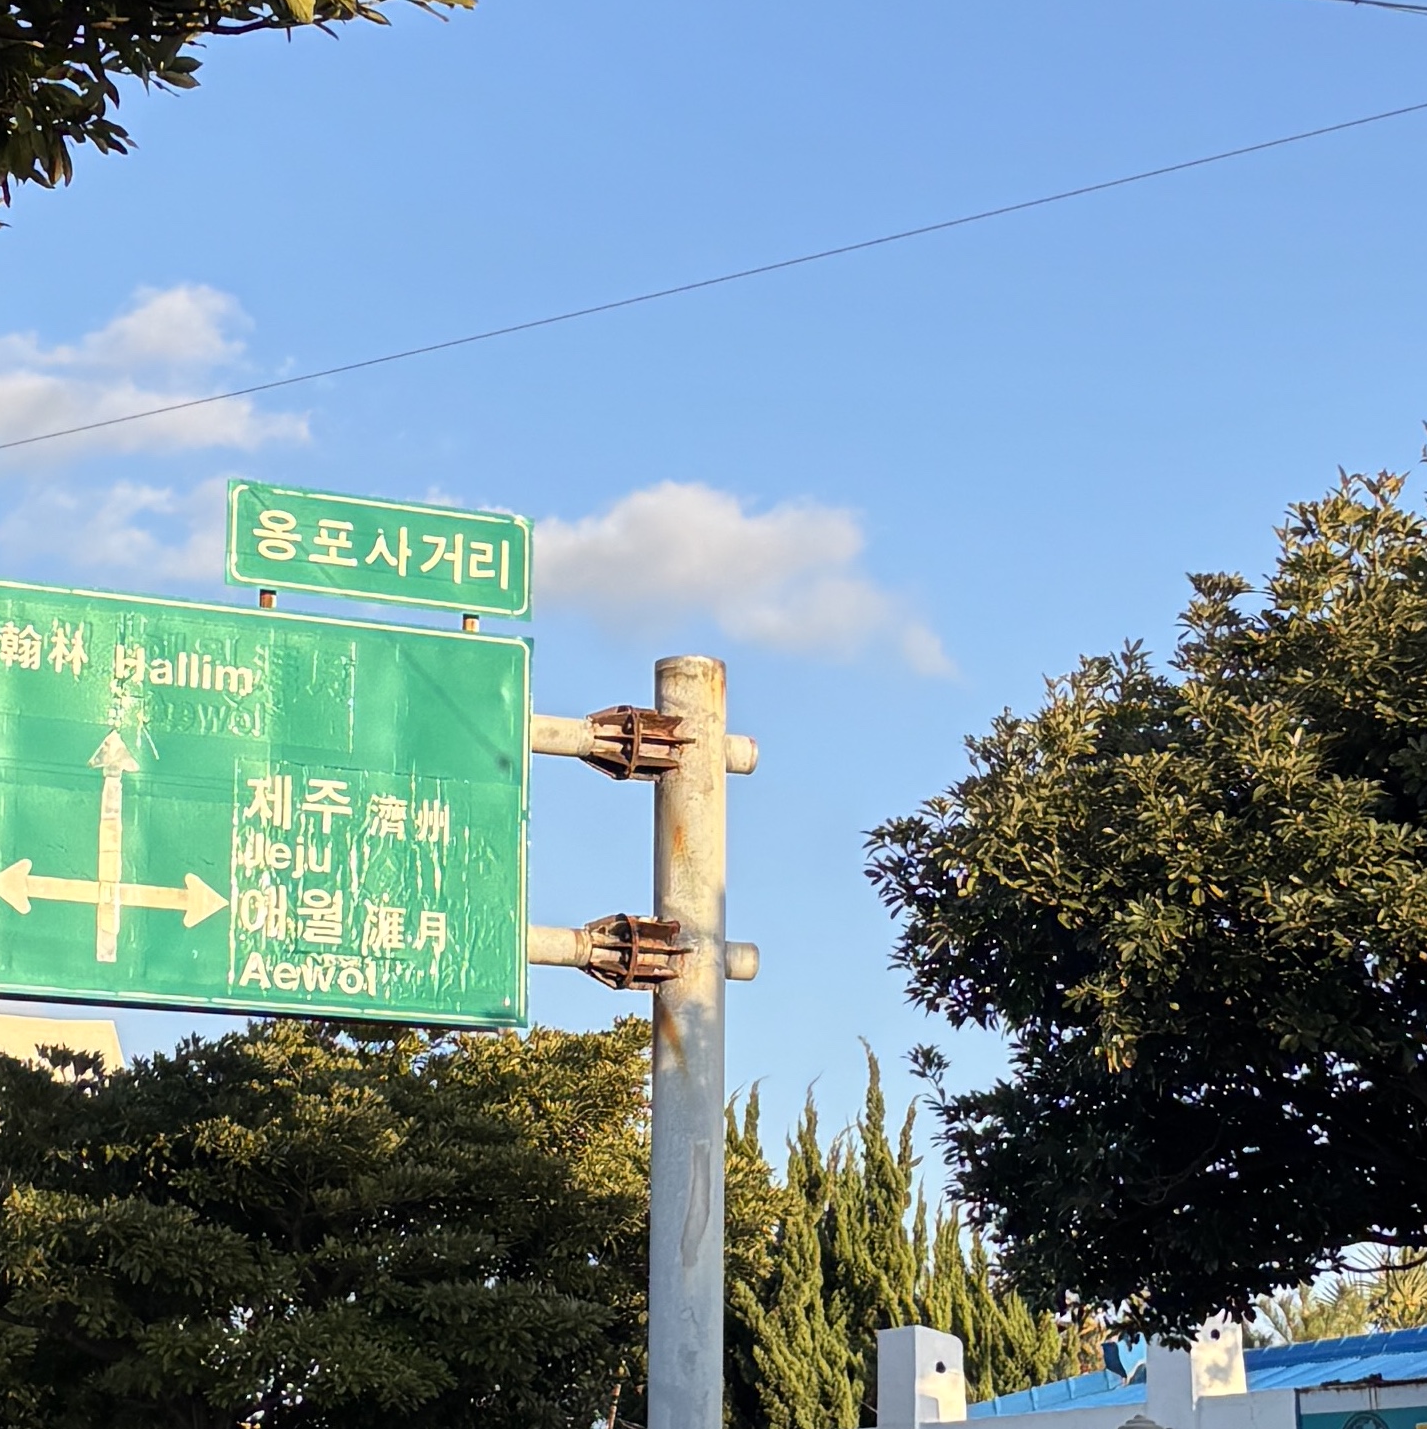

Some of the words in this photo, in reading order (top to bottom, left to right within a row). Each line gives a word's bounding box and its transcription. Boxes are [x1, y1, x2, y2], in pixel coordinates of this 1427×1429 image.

[253, 510, 510, 591] 옹포사거리
[113, 643, 254, 696] Hallim
[244, 774, 353, 835] 제주
[242, 831, 333, 879] Jeju
[238, 884, 344, 945] 애월
[238, 951, 377, 997] Aewol
